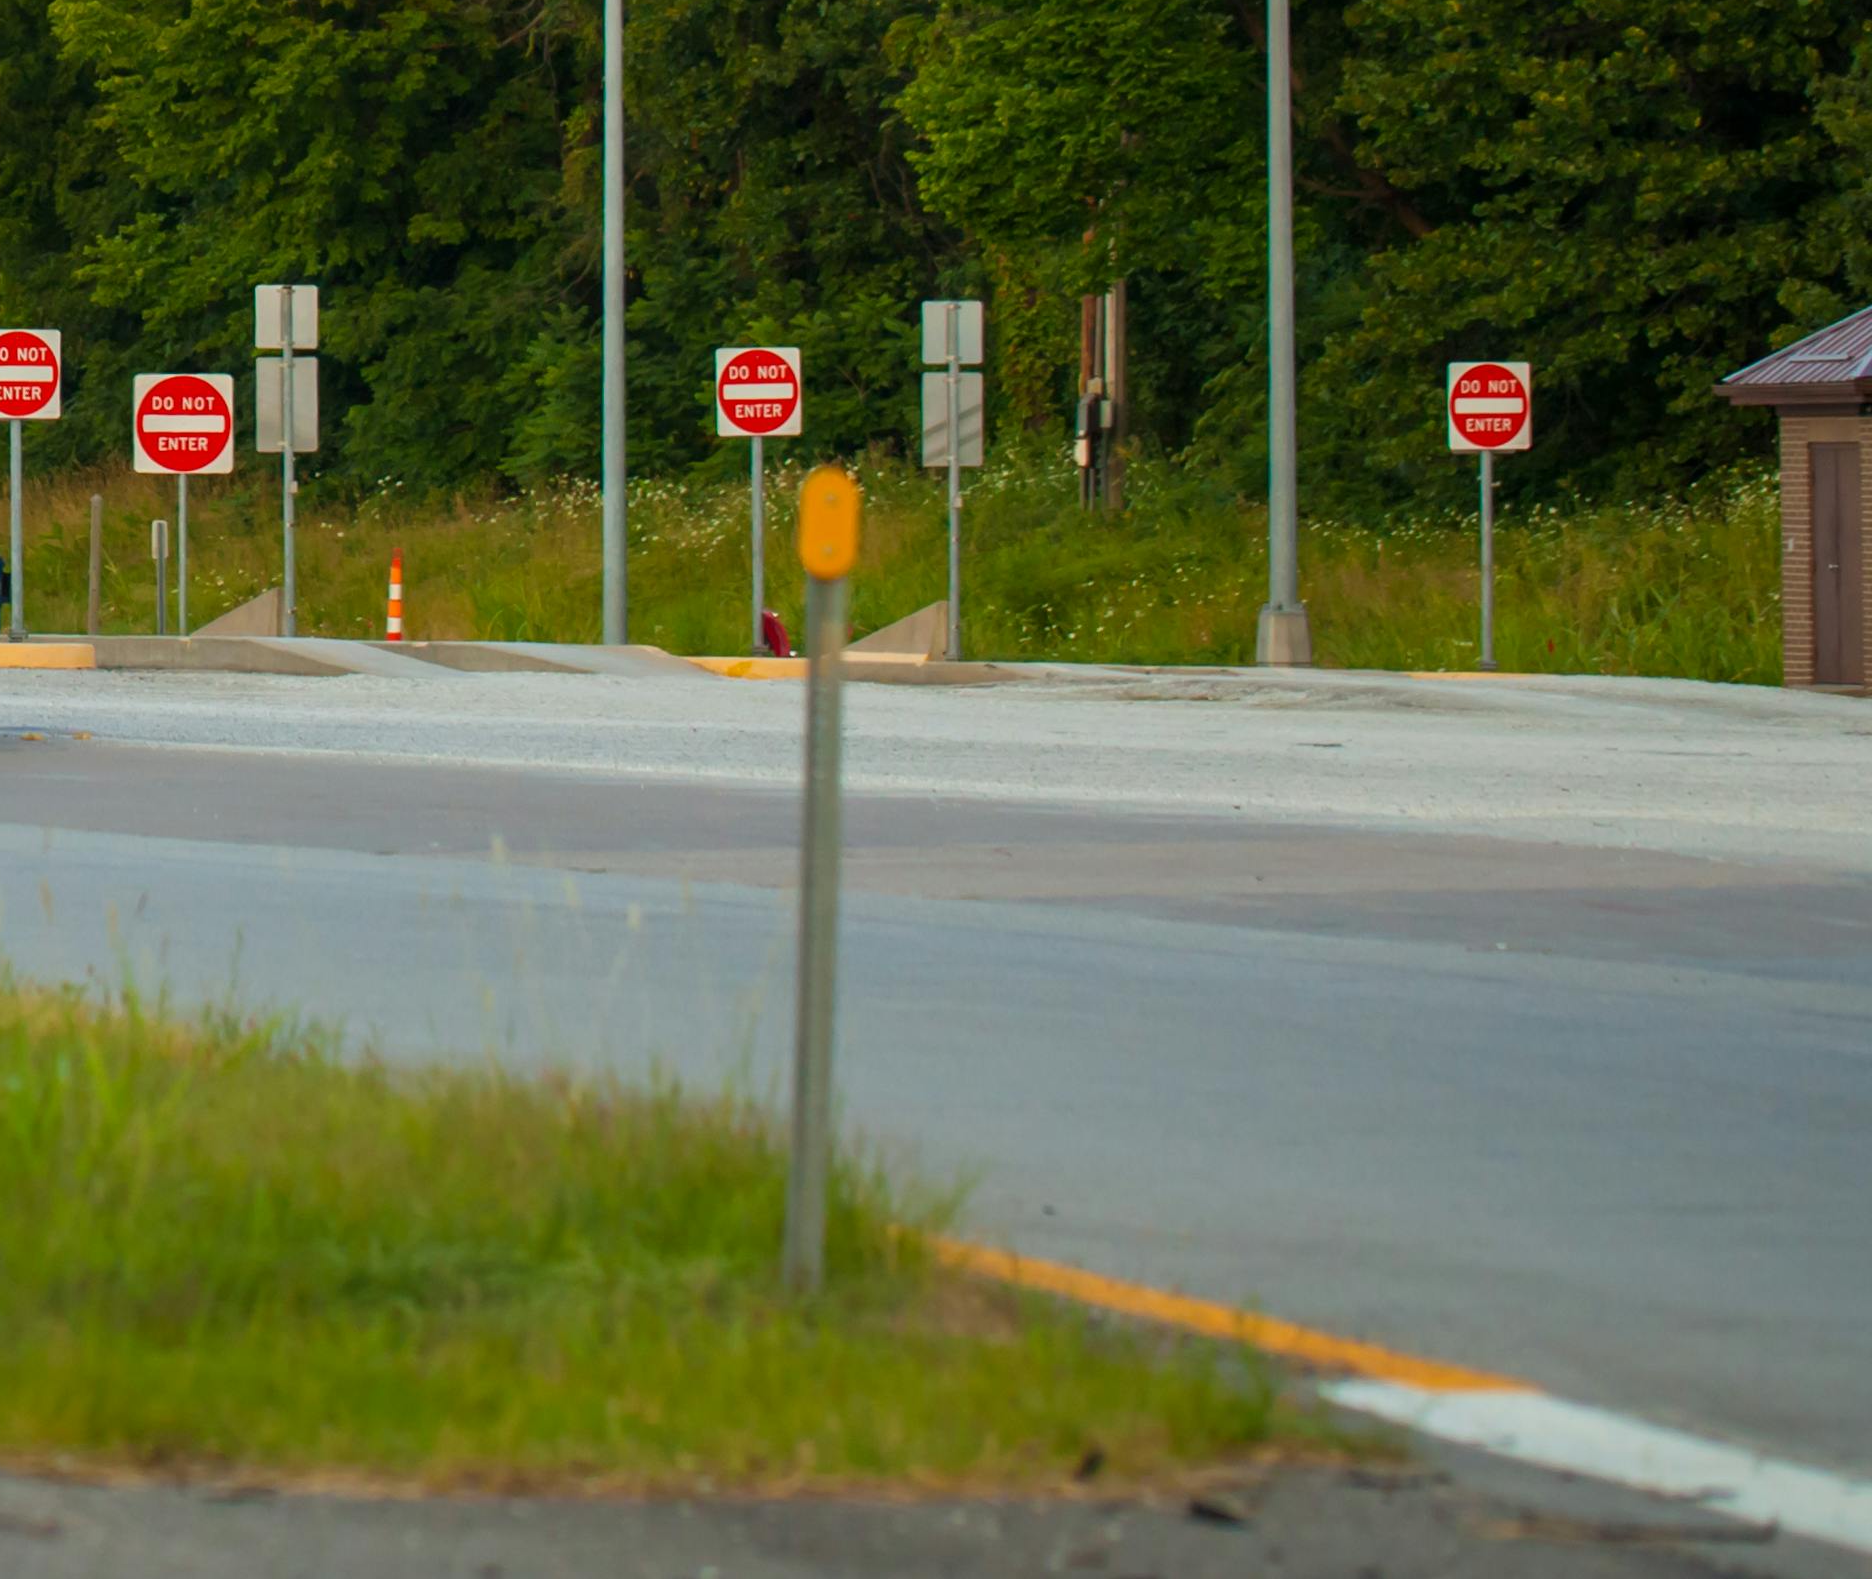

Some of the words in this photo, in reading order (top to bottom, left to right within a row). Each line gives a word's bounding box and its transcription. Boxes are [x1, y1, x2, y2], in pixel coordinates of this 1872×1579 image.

[17, 347, 47, 361] NOT
[729, 365, 749, 380] DO
[757, 364, 787, 379] NOT
[1460, 380, 1481, 394] DO
[1488, 379, 1517, 393] NOT
[152, 396, 174, 410] DO
[182, 396, 215, 410] NOT
[735, 404, 782, 418] ENTER
[1465, 418, 1512, 432] ENTER
[158, 437, 208, 451] ENTER
